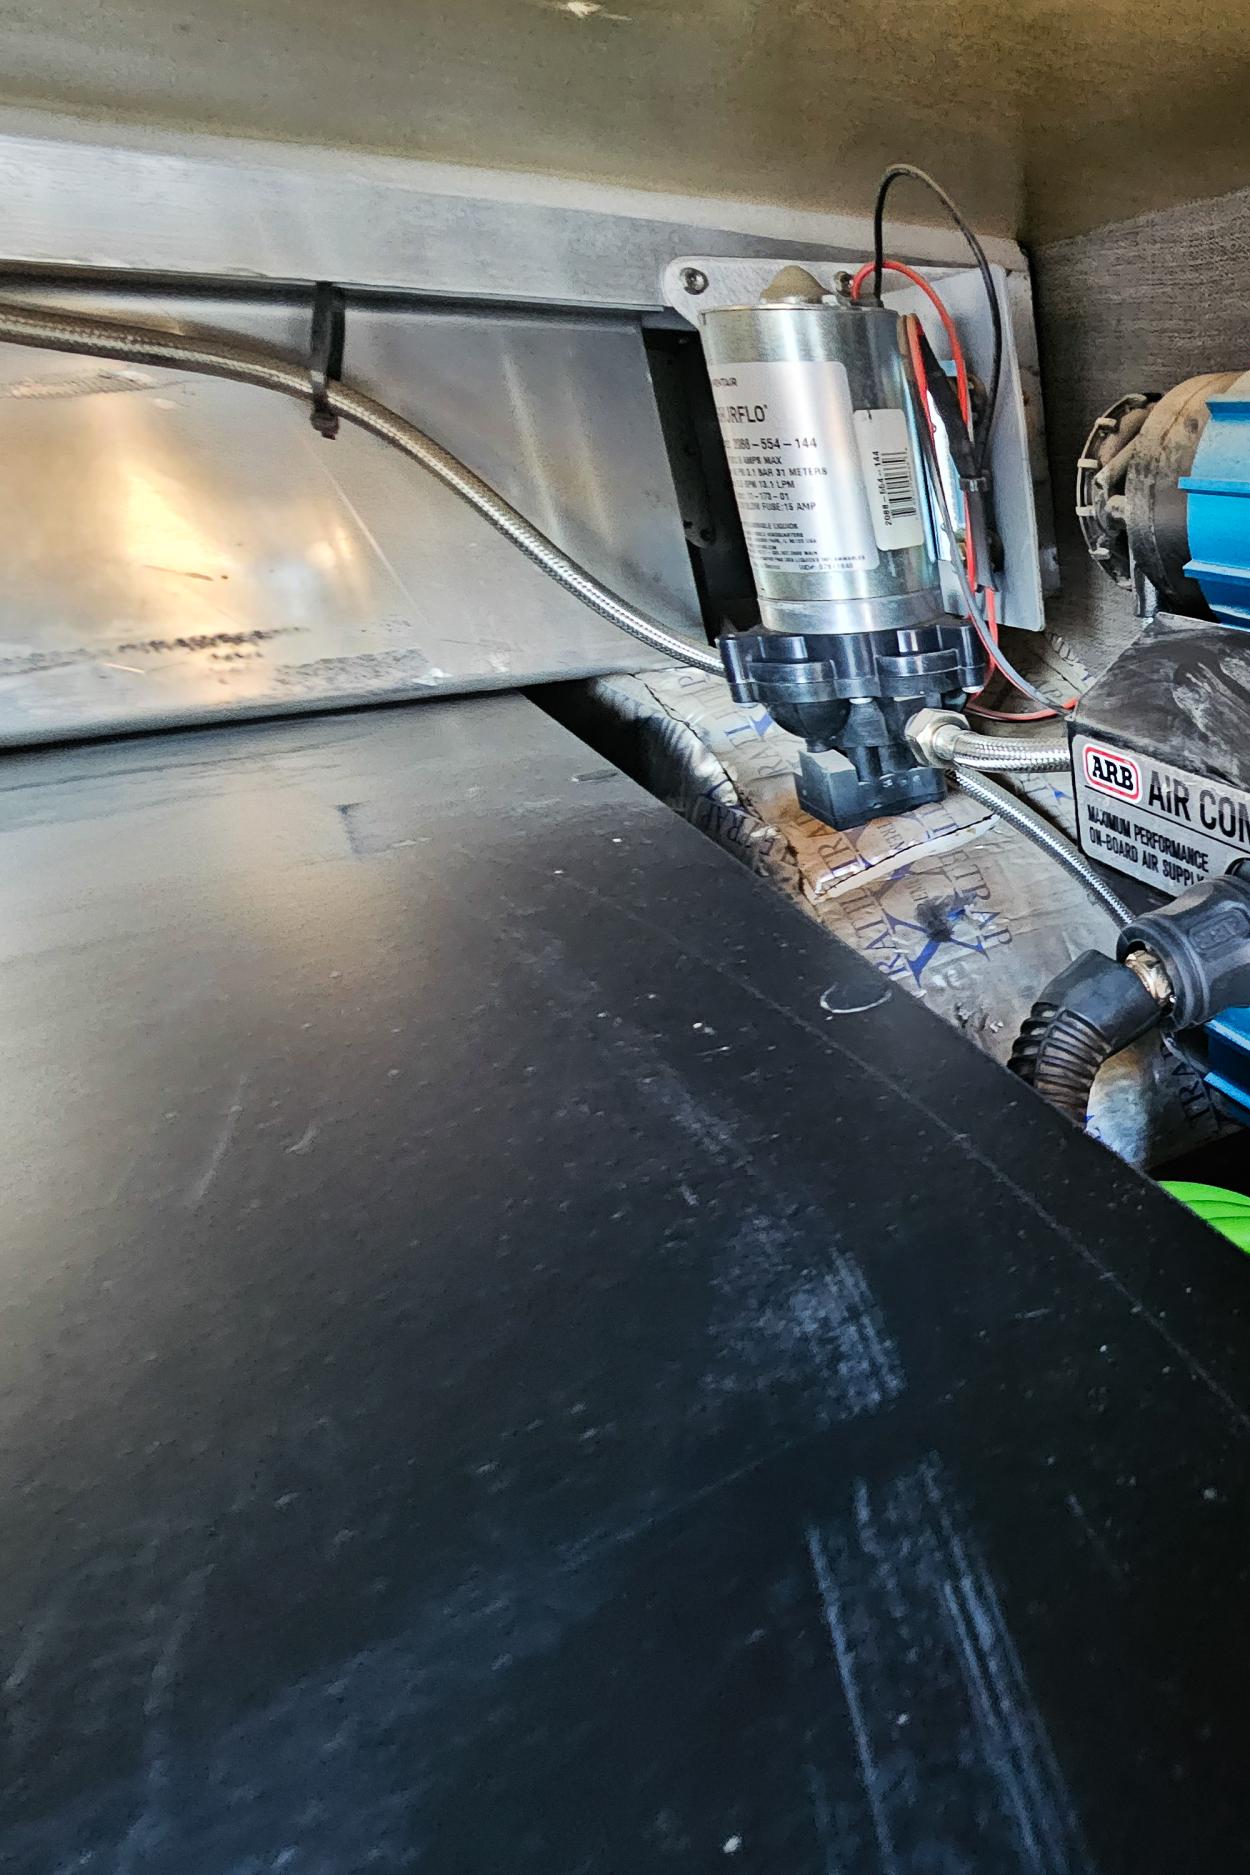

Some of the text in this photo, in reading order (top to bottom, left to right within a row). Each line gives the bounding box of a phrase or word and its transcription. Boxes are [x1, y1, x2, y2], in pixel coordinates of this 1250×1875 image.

[1092, 755, 1134, 791] ARB
[1148, 770, 1192, 822] AIR
[1087, 803, 1210, 873] MAXIMUM PERFORMANCE
[1089, 826, 1139, 863] ON-BOARD
[1141, 850, 1160, 873] AIR
